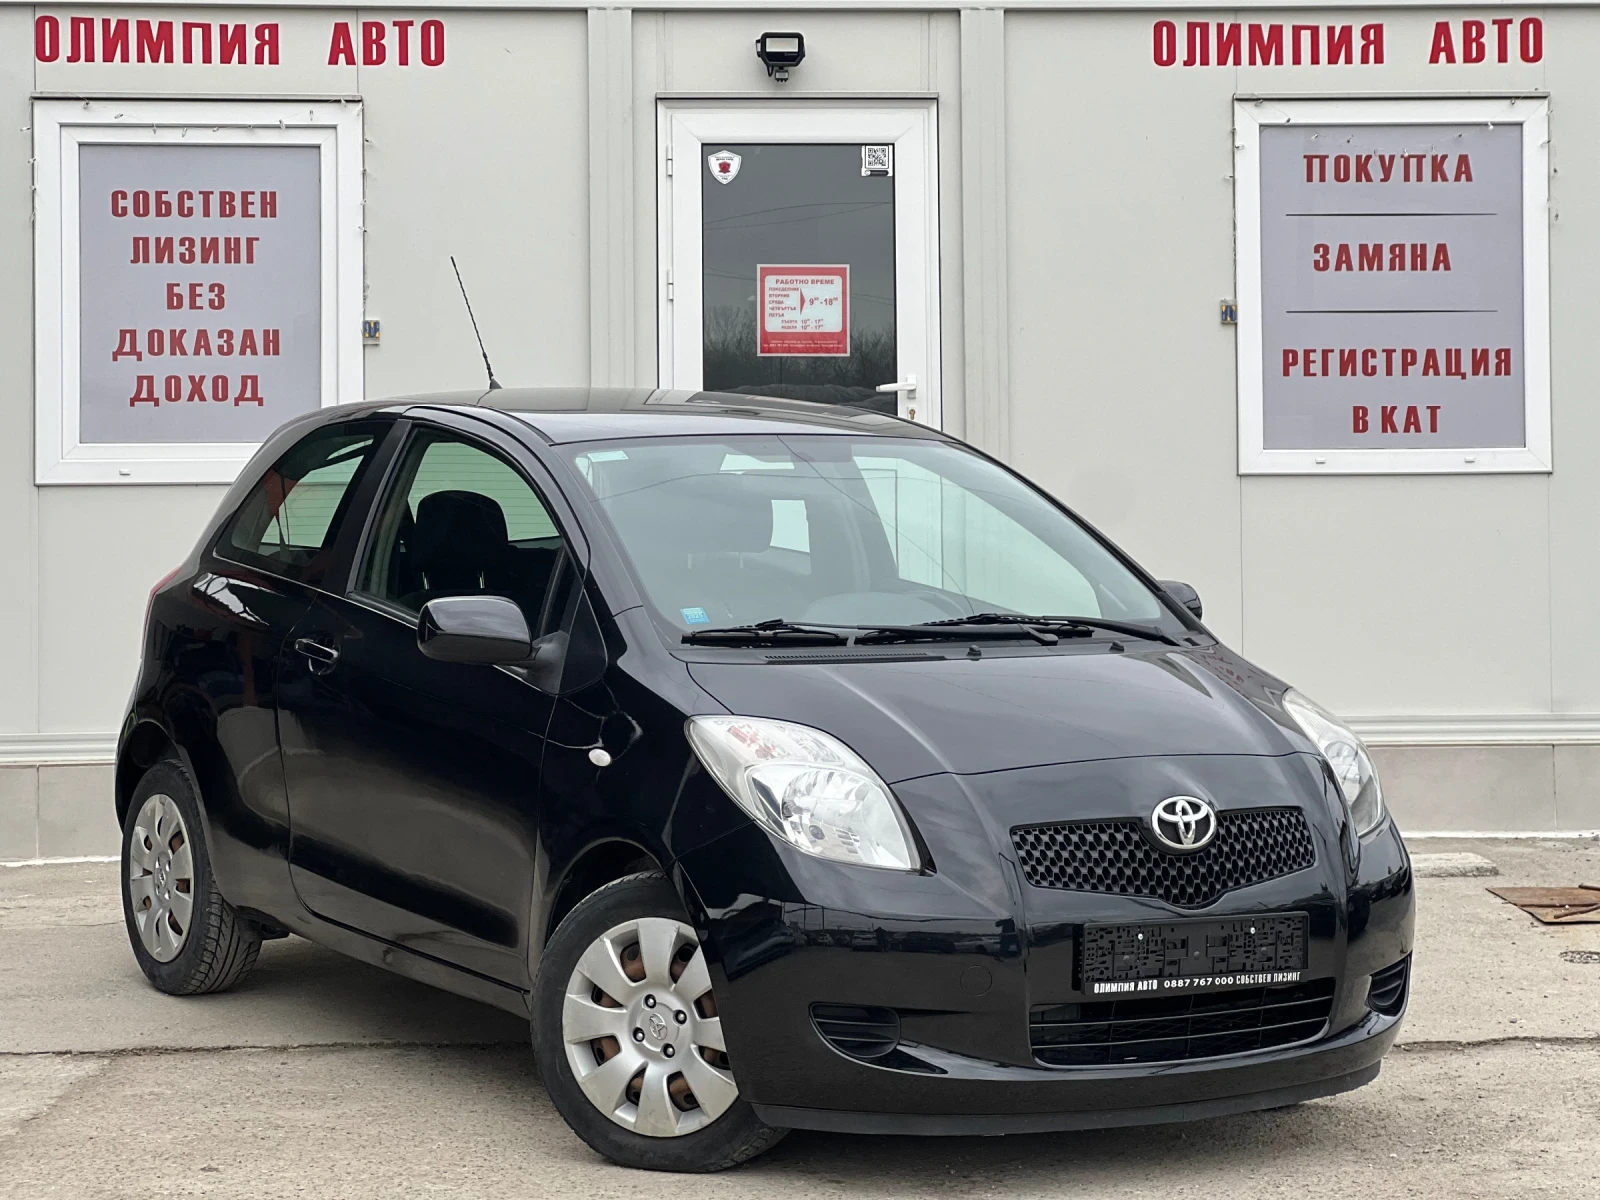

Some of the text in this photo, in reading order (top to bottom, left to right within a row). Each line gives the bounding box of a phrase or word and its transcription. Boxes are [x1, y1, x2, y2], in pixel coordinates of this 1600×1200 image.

[35, 15, 445, 67] ОЛИМПИЯ АВТО
[1153, 17, 1544, 67] ОЛИМПИЯ АВТО
[1304, 154, 1473, 183] ПОКУПКА
[111, 190, 277, 218] СОБСТВЕН
[130, 237, 260, 265] ЛИЗИНГ
[1313, 243, 1452, 272] ЗАМЯНА
[166, 283, 226, 311] БЕЗ
[112, 329, 281, 362] ДОКАЗАН
[1282, 348, 1512, 380] РЕГИСТРАЦИЯ
[129, 375, 265, 407] ДОХОД
[1352, 405, 1442, 434] В КАТ
[1094, 972, 1301, 994] ОЛИМПИЯ АВТО 0887 767 000 СОБСТВЕН ЛИЗИНГ
